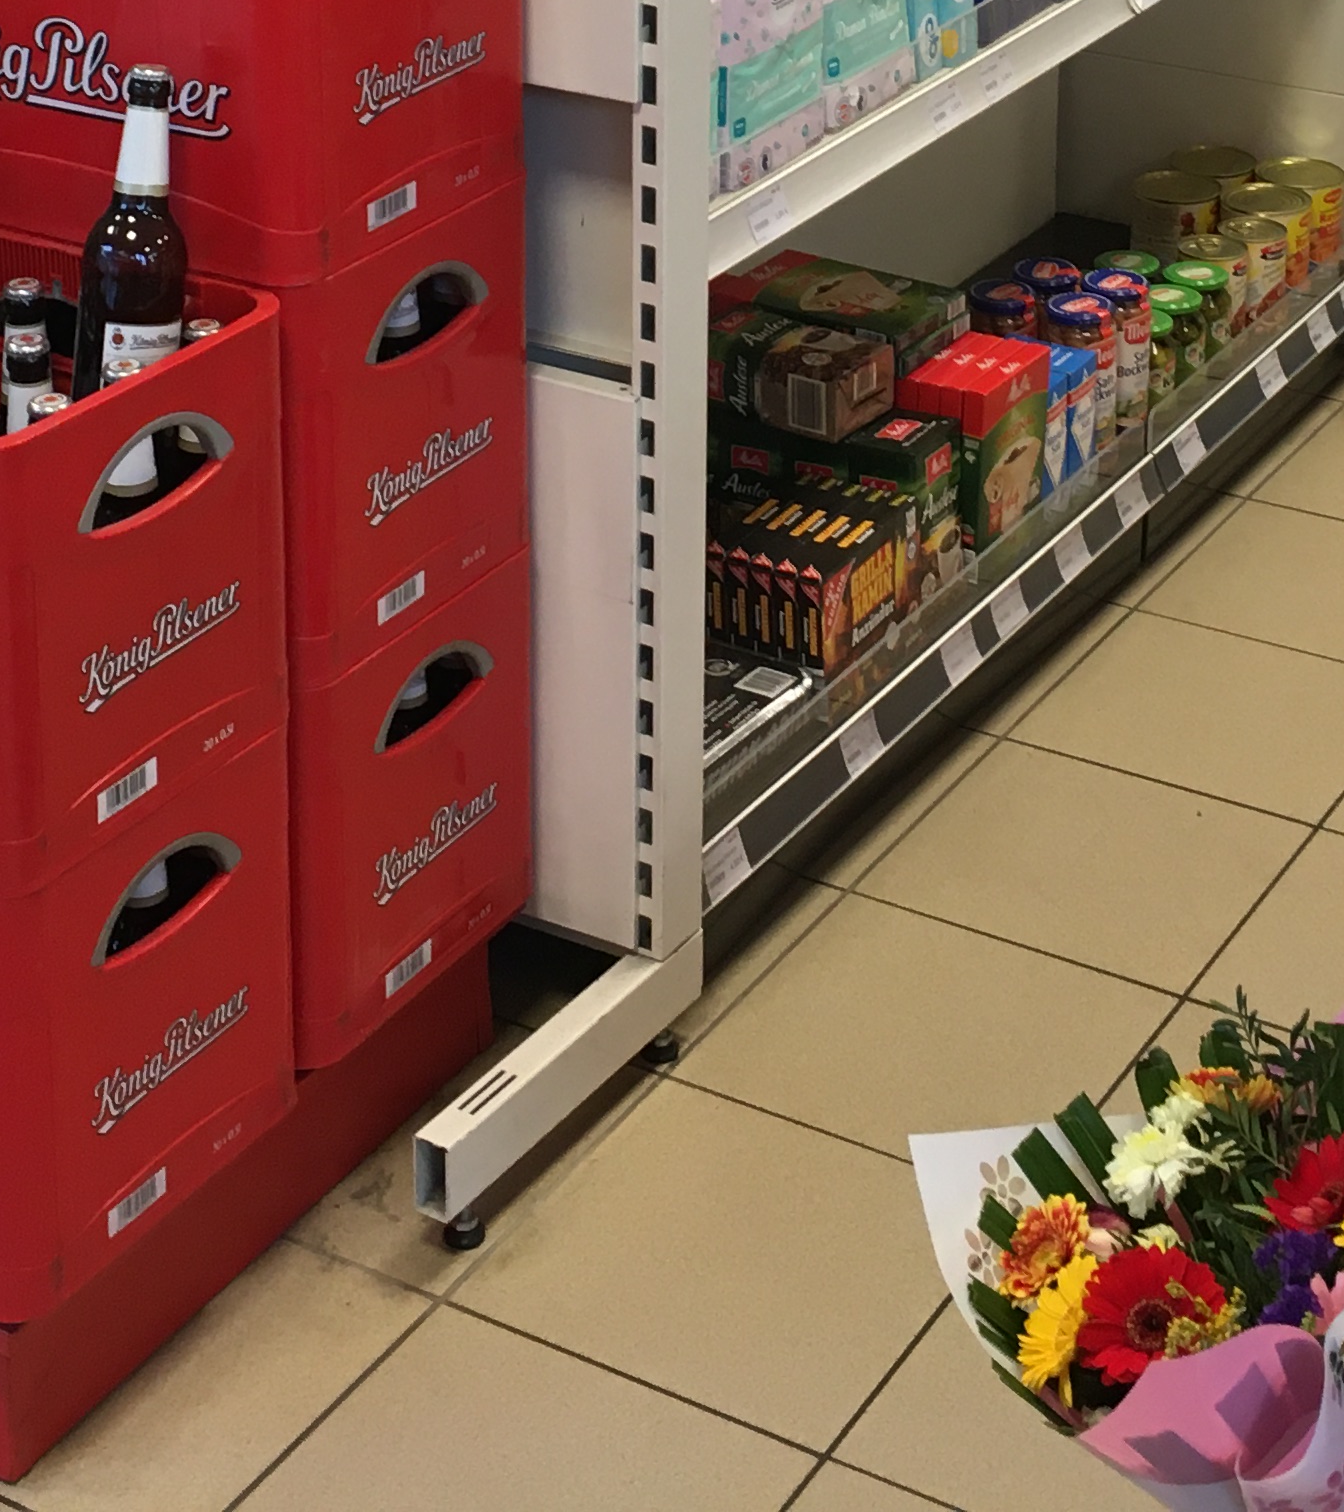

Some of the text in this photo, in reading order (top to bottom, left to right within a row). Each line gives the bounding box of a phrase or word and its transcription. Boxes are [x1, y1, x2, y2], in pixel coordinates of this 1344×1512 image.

[29, 16, 231, 138] Pilseer
[354, 30, 486, 125] König Pilsener
[729, 354, 749, 417] Auslese
[741, 317, 794, 347] Auslese
[364, 416, 493, 526] König Pilsener
[78, 580, 241, 713] König Pilsener
[373, 782, 497, 906] König Pilsener
[92, 984, 249, 1135] König Pilsener
